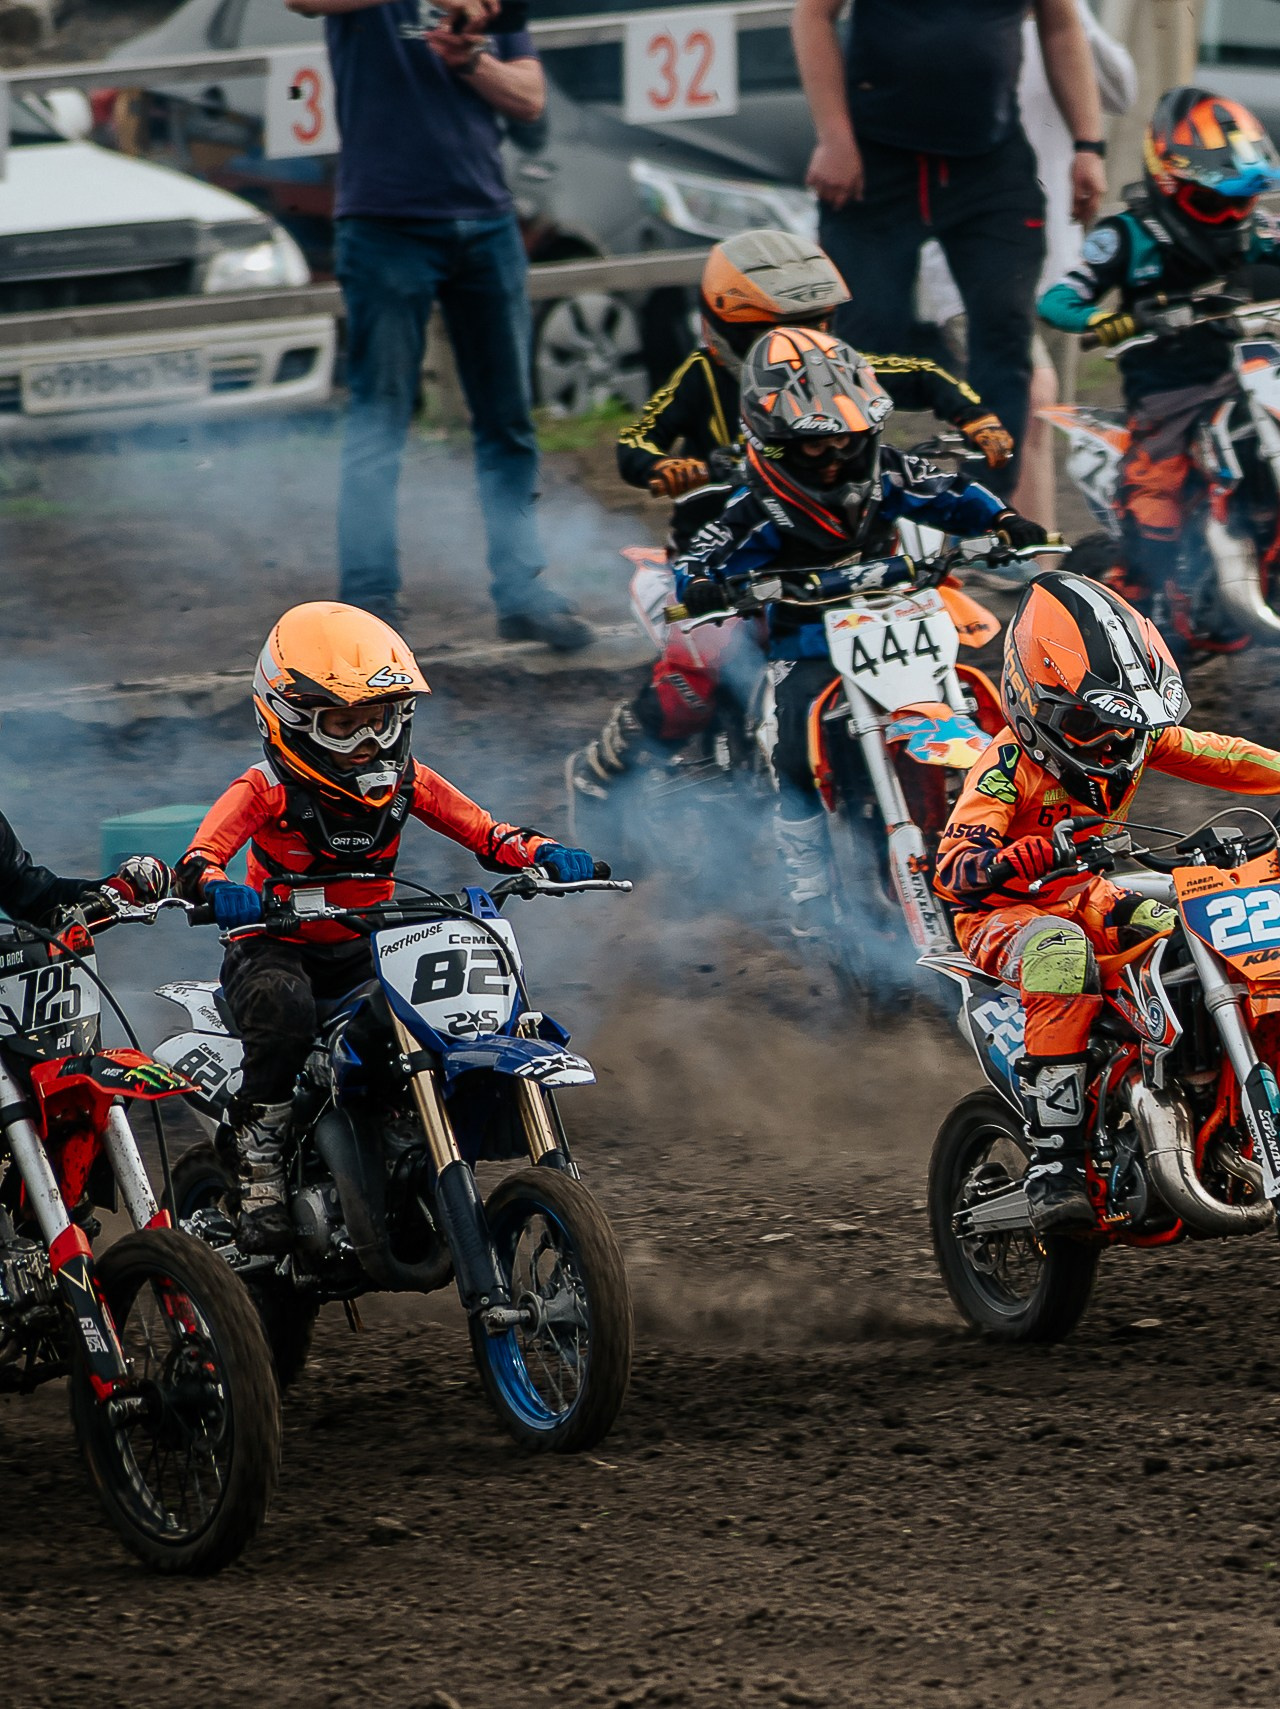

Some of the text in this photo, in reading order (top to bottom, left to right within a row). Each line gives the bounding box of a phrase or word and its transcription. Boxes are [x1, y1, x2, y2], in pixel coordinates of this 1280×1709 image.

[646, 29, 718, 111] 32
[851, 619, 941, 678] 444
[1091, 694, 1144, 725] Airoh
[1167, 682, 1184, 718] Airoh
[332, 837, 370, 846] ORTEMA
[1186, 875, 1214, 887] ПАВЕЛ
[379, 922, 444, 959] FASTHOUSE
[18, 961, 82, 1032] 125
[410, 948, 511, 1006] 82
[172, 1048, 229, 1098] 82
